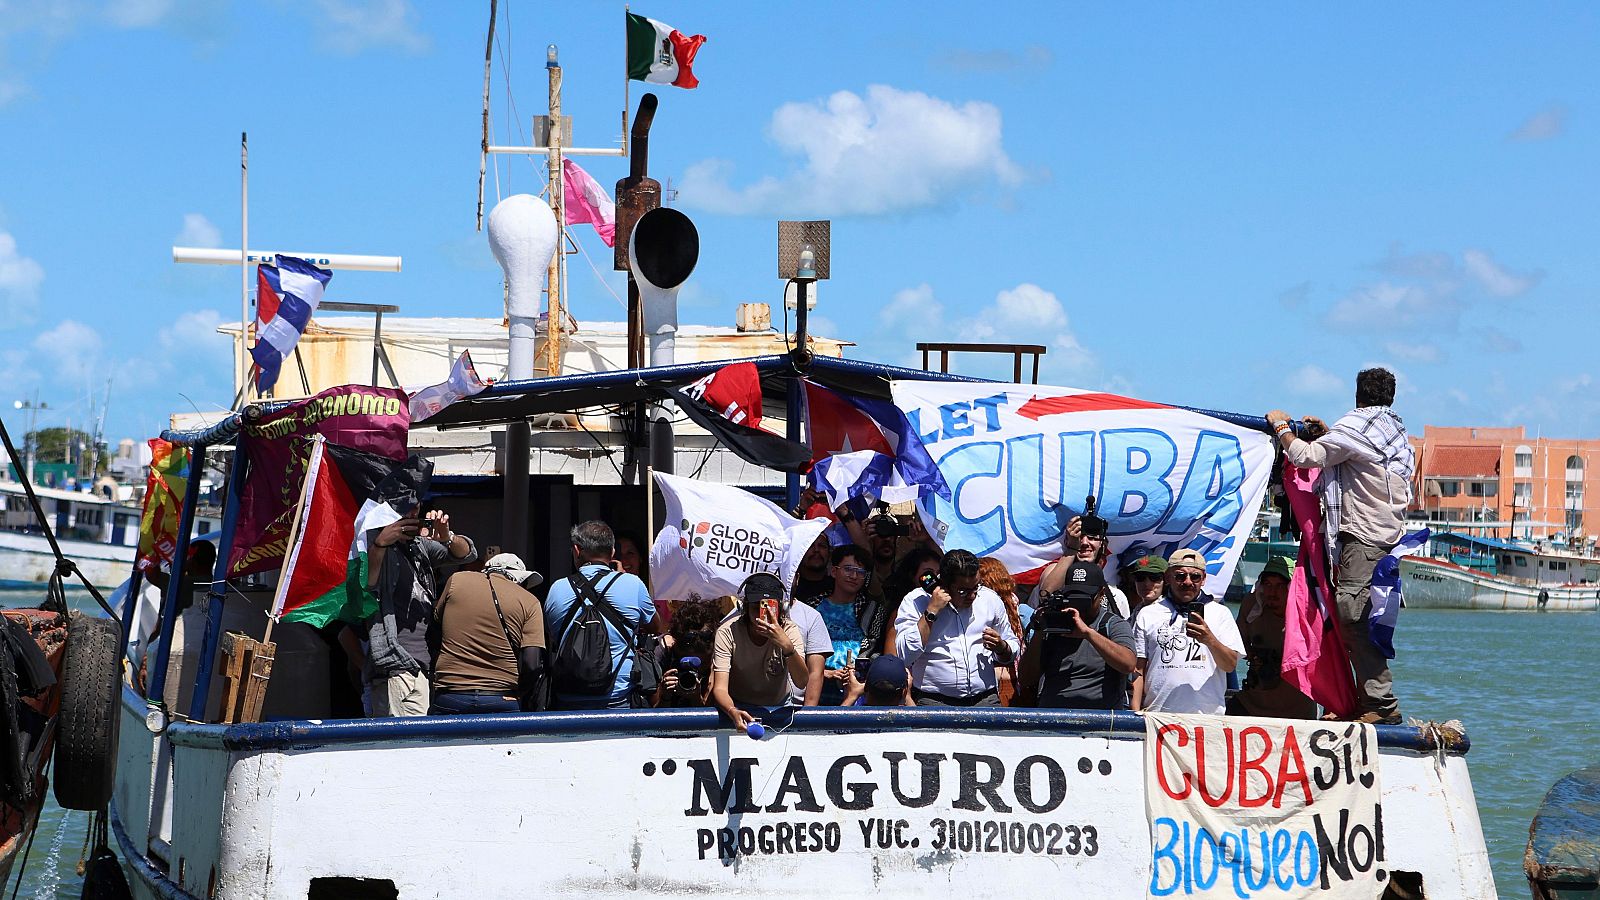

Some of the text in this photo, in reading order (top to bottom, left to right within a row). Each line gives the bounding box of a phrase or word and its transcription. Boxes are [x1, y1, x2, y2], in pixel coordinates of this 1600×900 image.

[904, 391, 1008, 446] LET
[926, 427, 1247, 558] CUBA
[708, 537, 775, 564] SUMUD
[711, 523, 783, 551] GLOBAL
[1155, 723, 1314, 809] CUBA
[697, 816, 1100, 861] PROGRESO YUC. 31012100233
